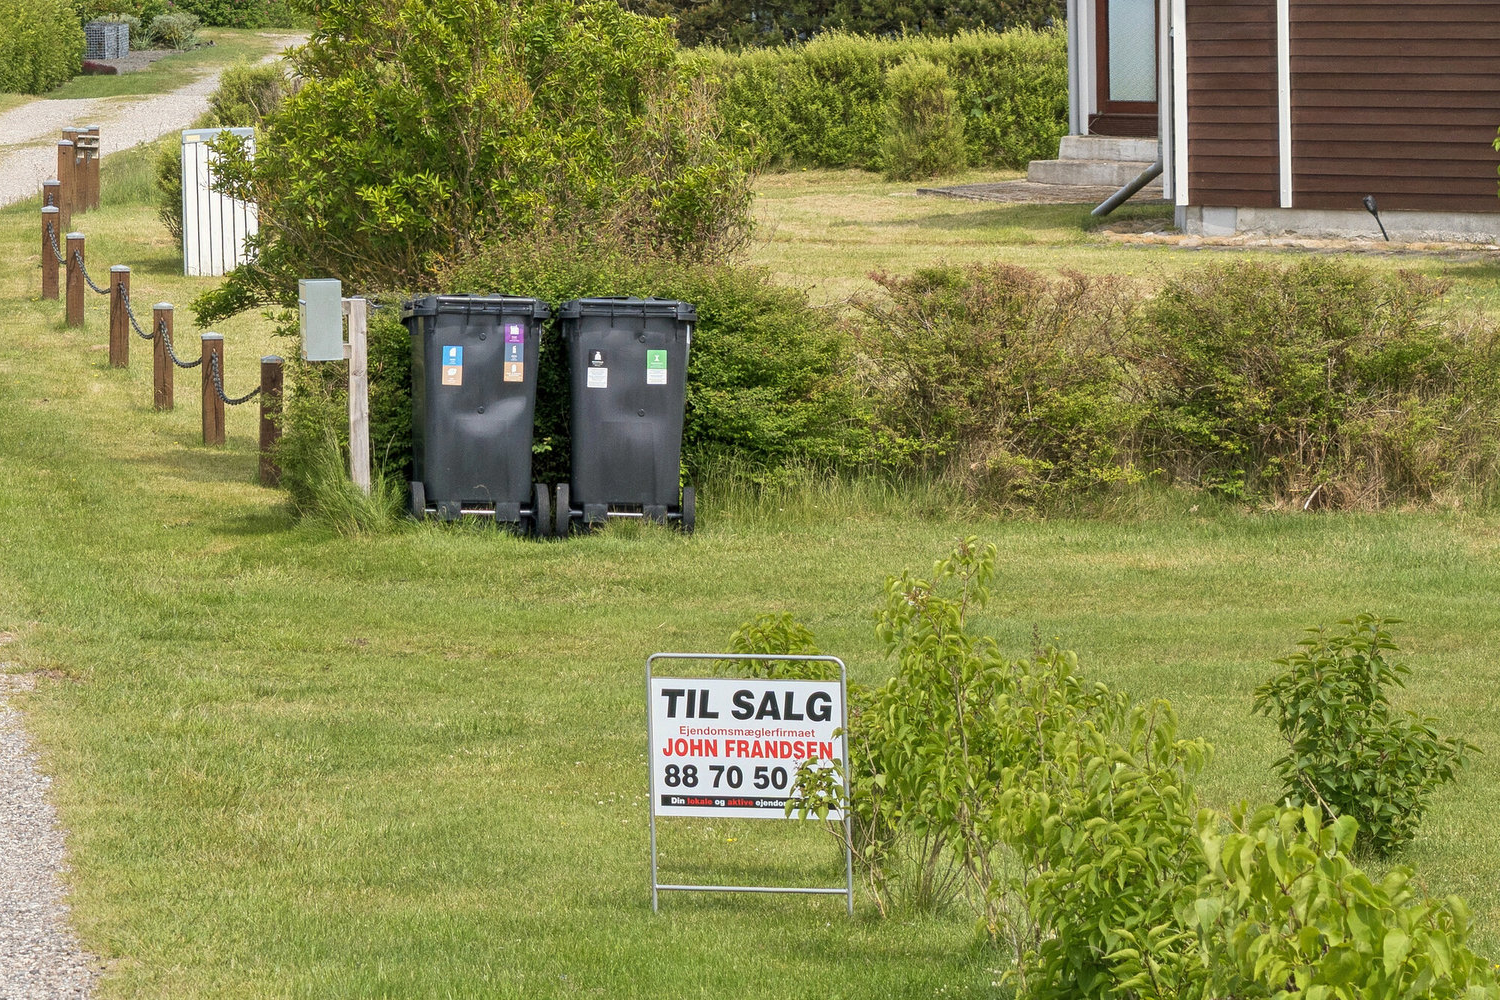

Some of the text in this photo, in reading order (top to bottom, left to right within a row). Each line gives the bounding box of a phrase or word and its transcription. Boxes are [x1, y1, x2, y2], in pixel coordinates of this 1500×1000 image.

[661, 688, 833, 722] TIL SALG
[679, 725, 816, 738] Ejendomsmæglerfirmaet
[662, 738, 834, 760] JOHN FRANDSEN
[664, 763, 699, 788] 88
[709, 765, 744, 789] 70
[753, 766, 788, 790] 50
[671, 797, 686, 805] Din
[687, 797, 713, 806] lokale
[714, 799, 726, 807] og
[727, 798, 754, 806] aktive
